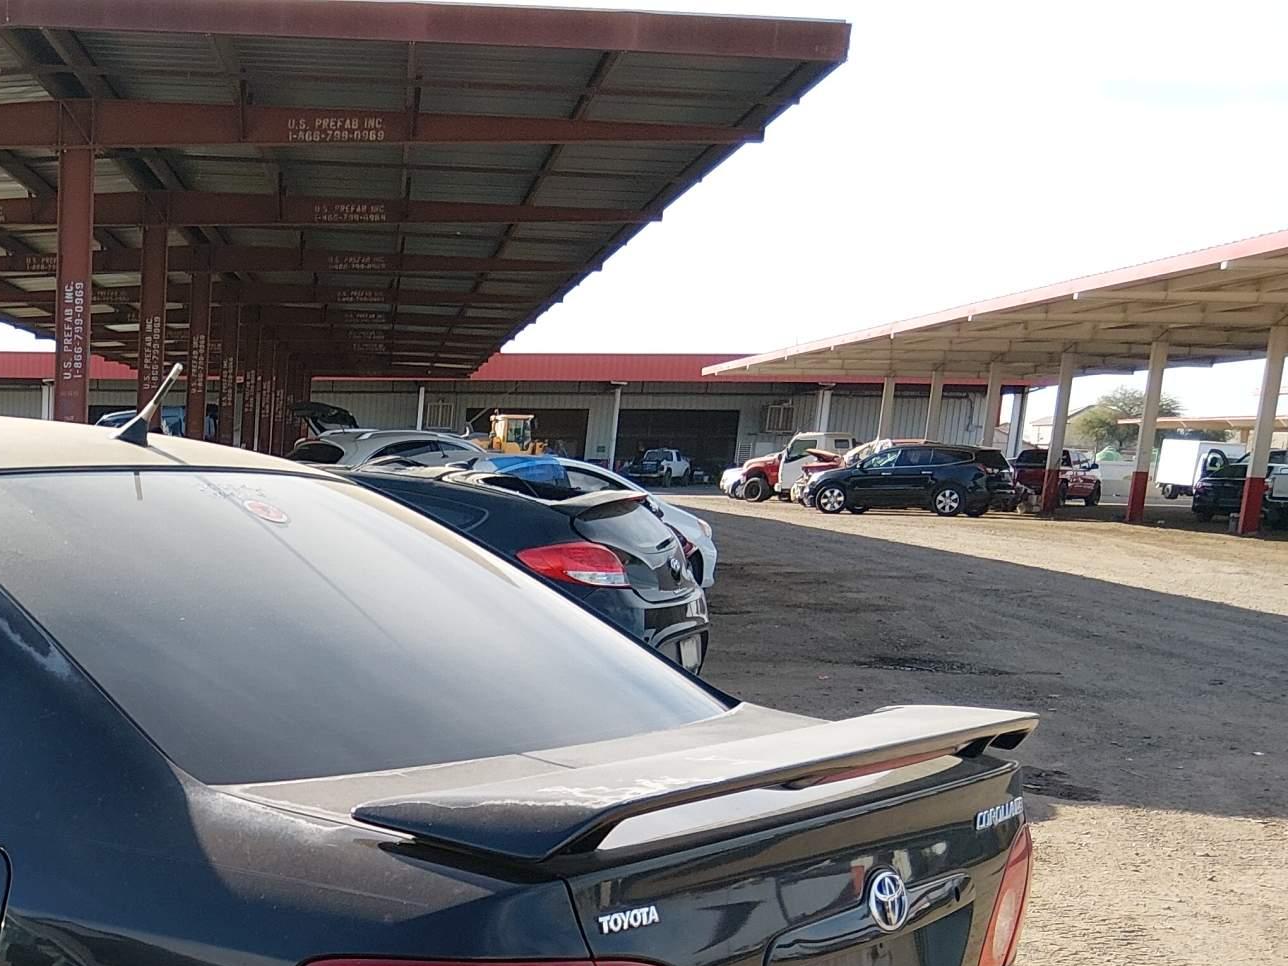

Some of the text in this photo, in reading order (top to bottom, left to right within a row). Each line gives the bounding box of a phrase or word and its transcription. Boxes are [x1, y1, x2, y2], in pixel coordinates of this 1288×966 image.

[287, 118, 310, 130] U.S.
[315, 118, 359, 130] PREFAB
[65, 281, 74, 303] INC.
[64, 308, 73, 352] PREFAB
[73, 282, 84, 379] 1-866-799-0969
[144, 336, 153, 369] PREFAB
[64, 357, 73, 380] U.S.
[976, 800, 1015, 830] COROLLA
[598, 905, 660, 934] TOYOTA
